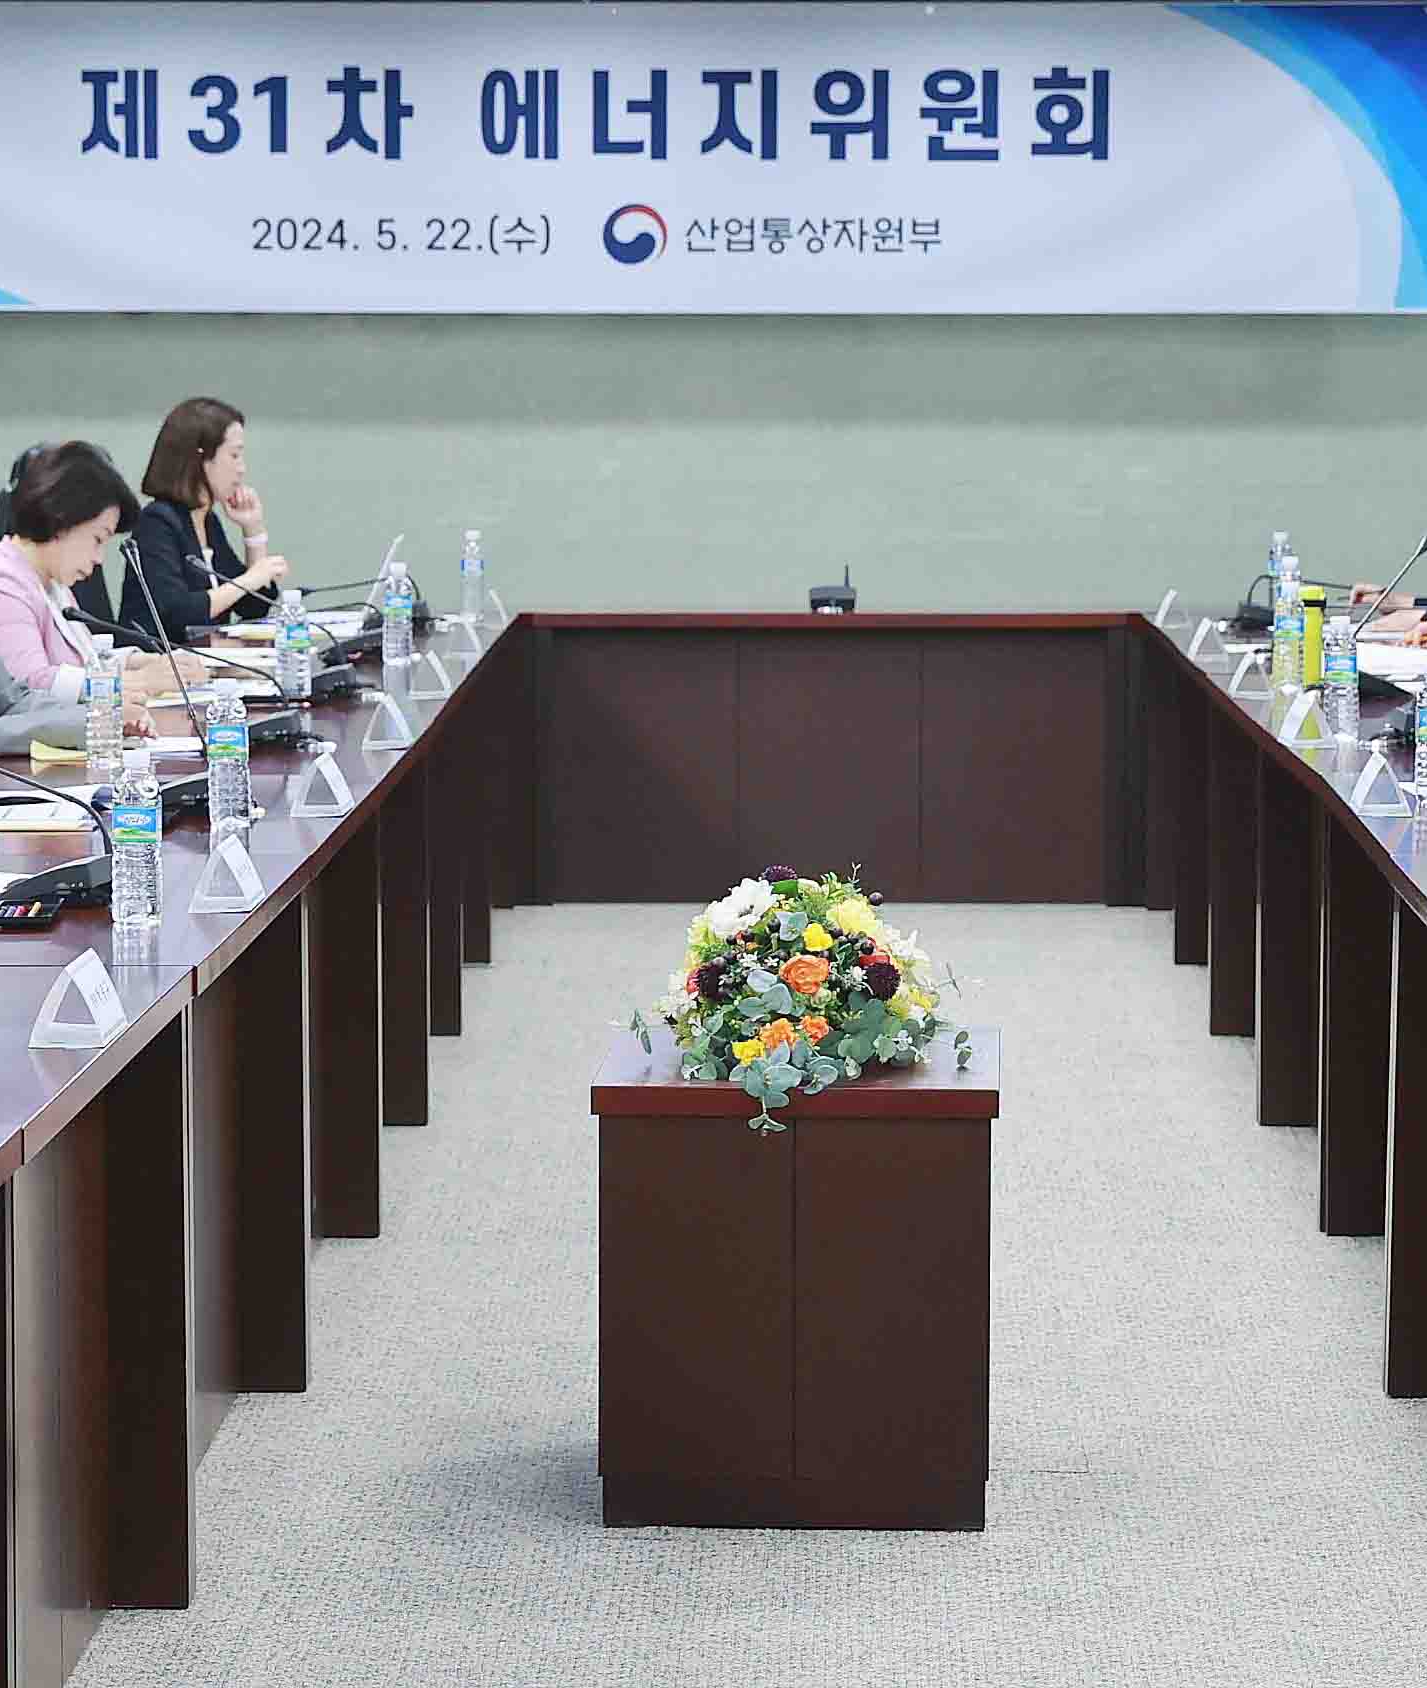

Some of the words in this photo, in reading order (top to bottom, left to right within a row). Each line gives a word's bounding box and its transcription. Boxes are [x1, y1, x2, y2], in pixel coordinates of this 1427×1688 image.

[80, 66, 415, 160] 제31차
[480, 65, 1111, 160] 에너지위원회
[252, 217, 360, 251] 2024.
[376, 217, 408, 251] 5.
[425, 214, 551, 256] 22.(수)
[685, 217, 942, 255] 산업통상자원부
